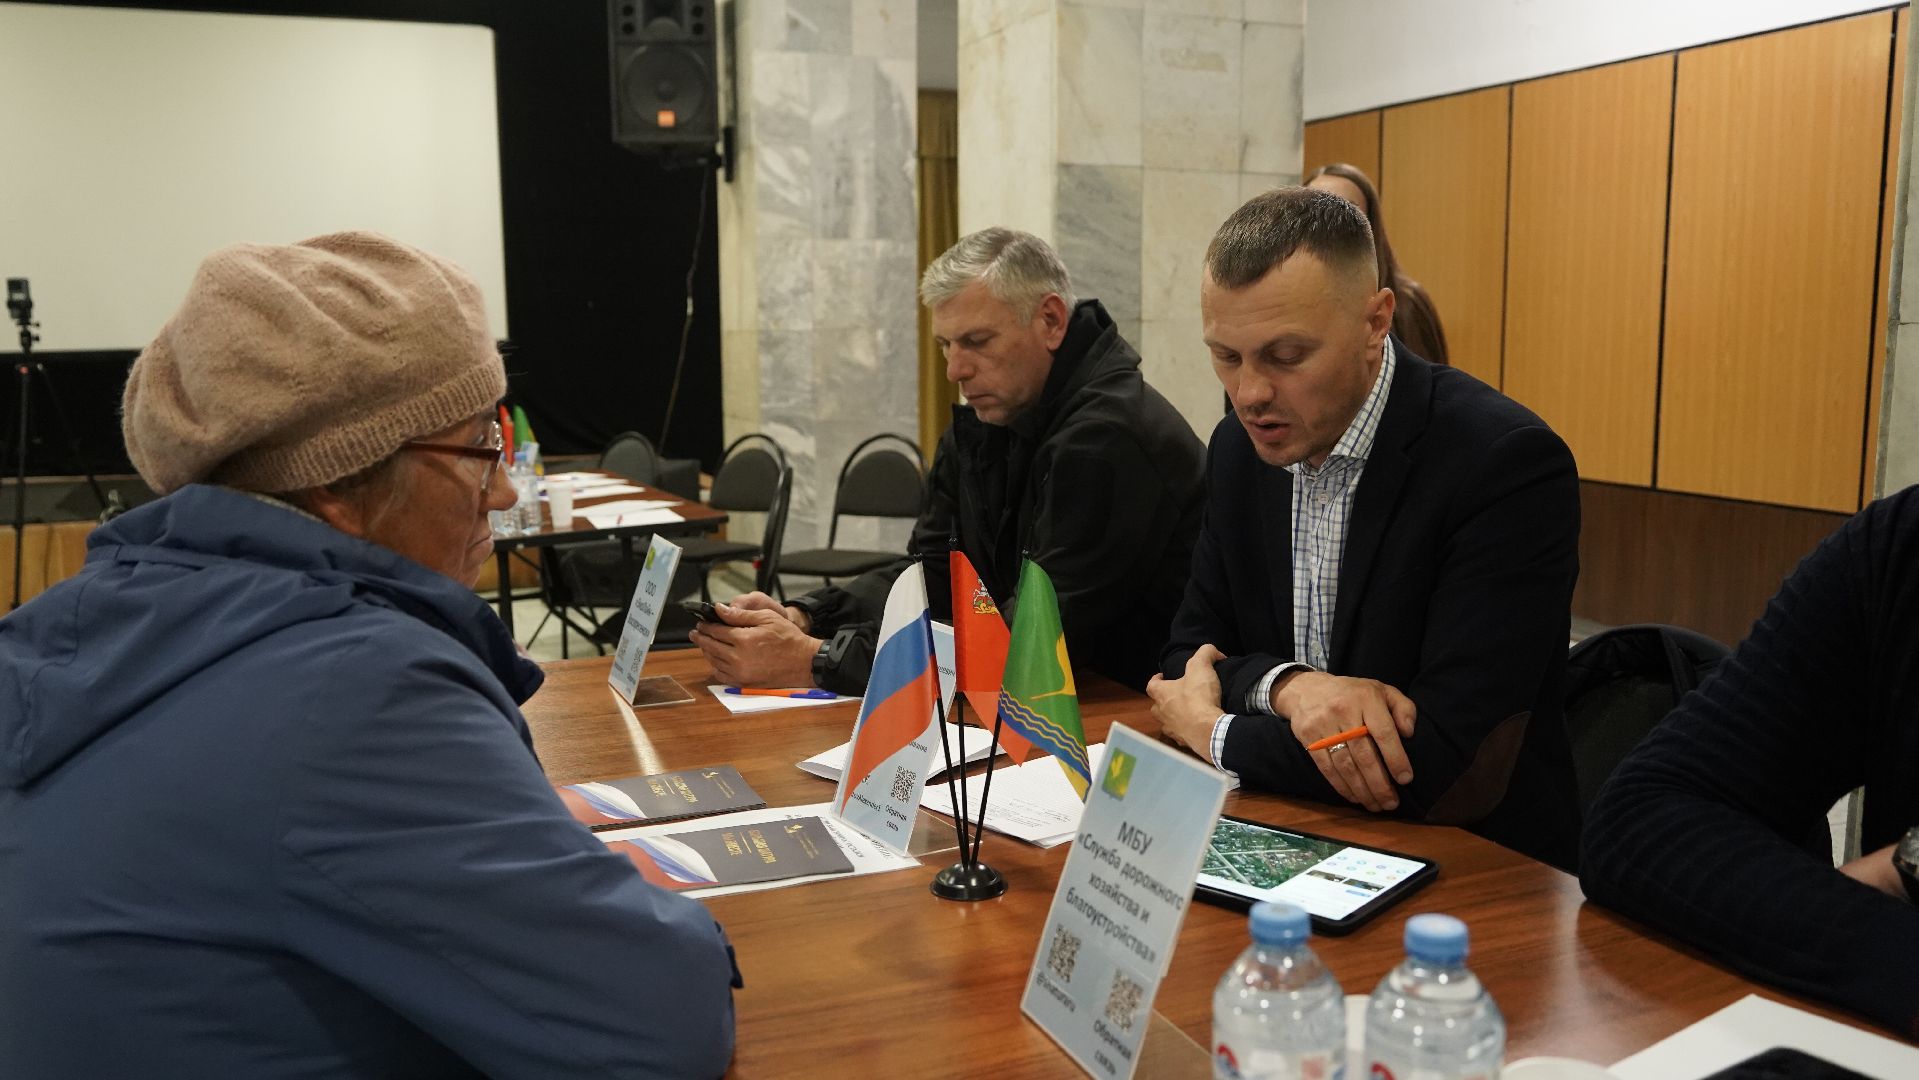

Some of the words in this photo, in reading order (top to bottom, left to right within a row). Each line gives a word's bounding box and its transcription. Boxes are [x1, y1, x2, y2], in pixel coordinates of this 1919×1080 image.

[1078, 832, 1122, 869] «Служба
[1117, 820, 1154, 855] МБУ
[1088, 872, 1141, 918] хозяйства
[1140, 908, 1150, 924] и
[1065, 886, 1157, 964] благоустройства»
